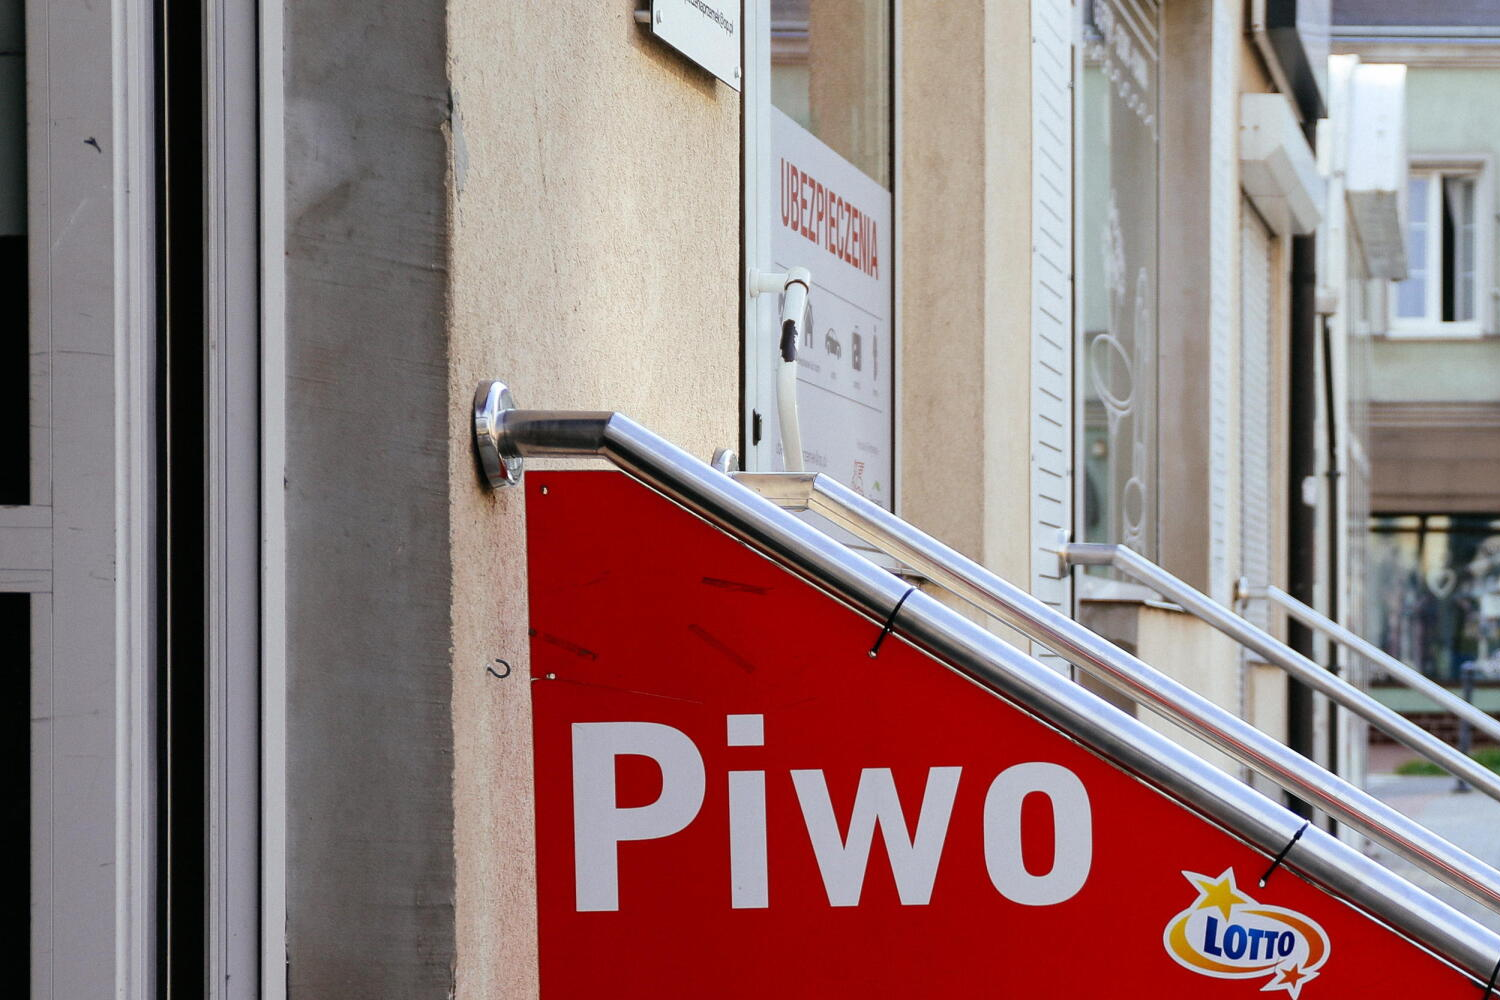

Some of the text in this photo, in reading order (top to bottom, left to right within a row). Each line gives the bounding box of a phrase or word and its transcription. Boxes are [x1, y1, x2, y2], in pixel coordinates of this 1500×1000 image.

[780, 157, 879, 281] UBEZPIECZENIA
[570, 713, 1093, 912] Piwo
[1203, 915, 1296, 960] LOTTO
